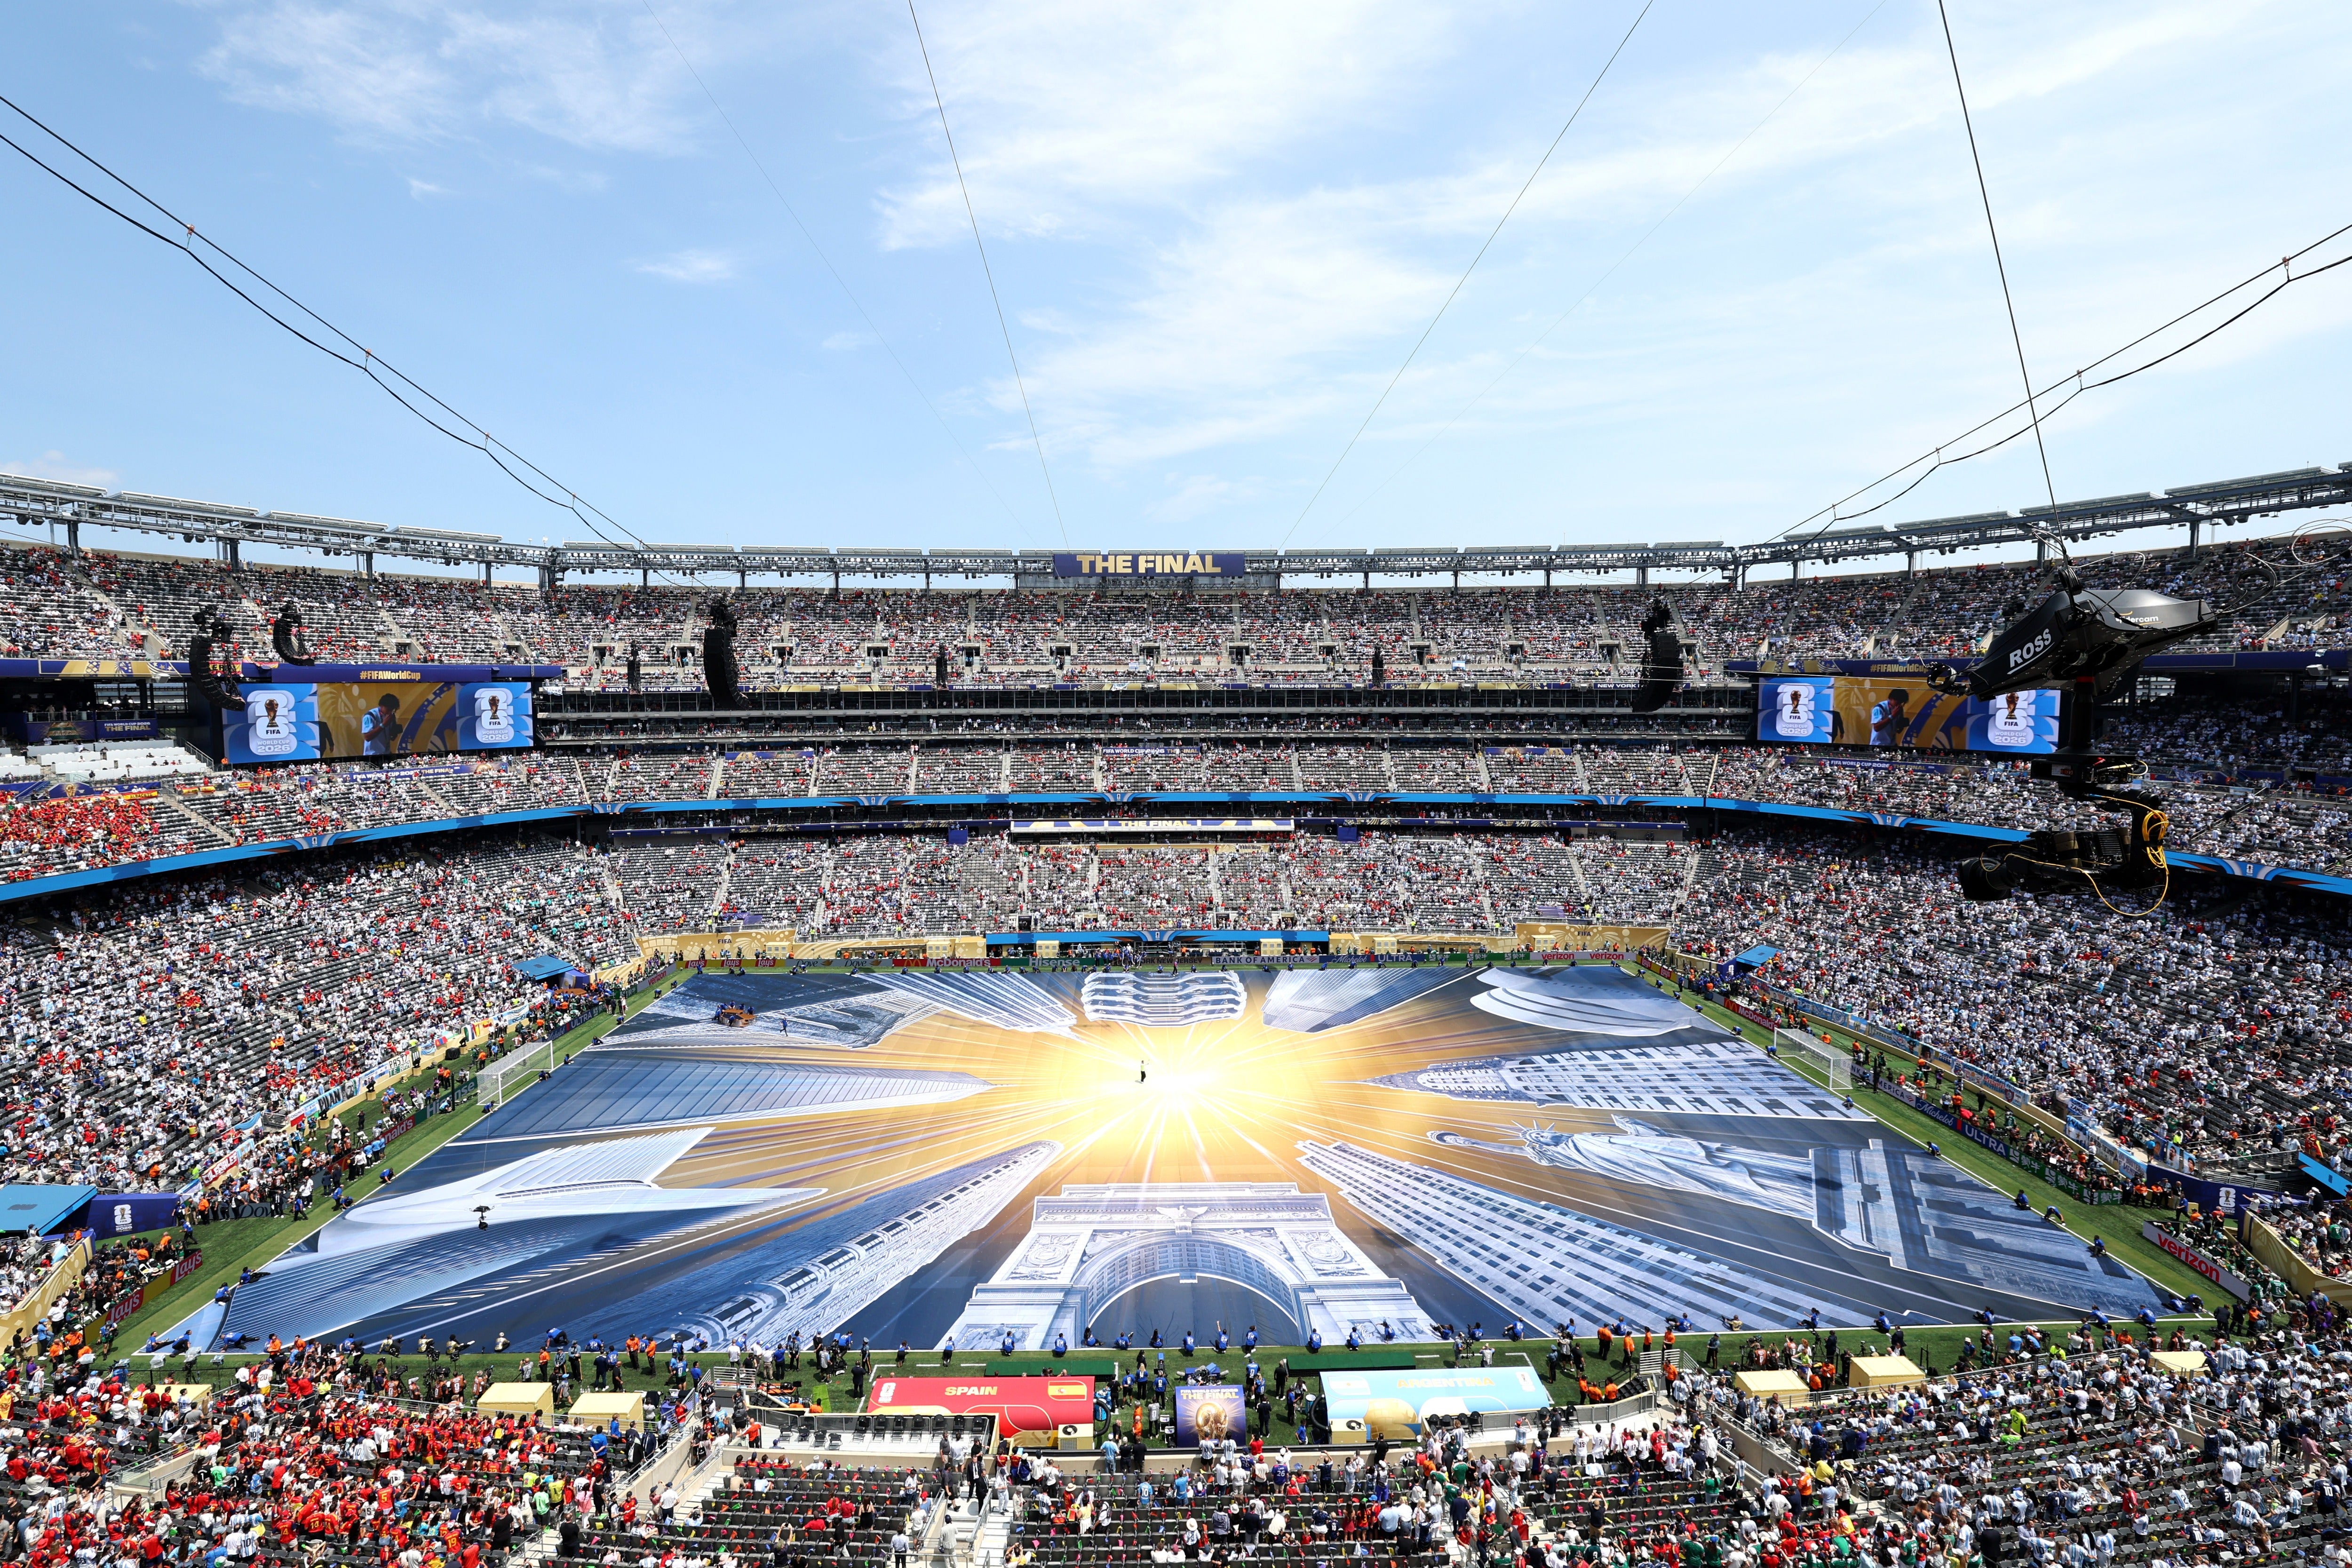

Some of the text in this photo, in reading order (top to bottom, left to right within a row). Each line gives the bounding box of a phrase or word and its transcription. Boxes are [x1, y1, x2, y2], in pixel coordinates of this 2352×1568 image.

[1077, 556, 1221, 573] THE FINAL
[2010, 629, 2052, 668] ROSS
[359, 670, 421, 680] #FIFAWorldCup
[796, 958, 818, 967] Dove
[926, 958, 991, 967] McDonald's
[1029, 958, 1080, 966] Hisense
[648, 971, 667, 986] verizon
[572, 1012, 592, 1028] ULTRA
[1739, 1006, 1778, 1029] McDonald's
[1878, 1081, 1905, 1098] MERICA
[385, 1119, 413, 1143] nald's
[1916, 1100, 2006, 1156] Michelob ULTRA
[2021, 1155, 2041, 1173] 蒙牛
[2058, 1175, 2078, 1194] 蒙牛
[2101, 1193, 2122, 1204] 蒙牛
[239, 1204, 272, 1218] Dov
[2158, 1233, 2220, 1283] verizon
[175, 1250, 202, 1283] Lay's
[111, 1293, 140, 1323] Lay's
[1398, 1377, 1495, 1388] ARGENTINA
[945, 1386, 997, 1396] SPAIN
[2012, 1416, 2018, 1424] 12
[2324, 1487, 2333, 1496] 10
[382, 1493, 387, 1502] 5
[2182, 1495, 2187, 1504] 2
[54, 1503, 62, 1512] 10
[2242, 1507, 2251, 1517] 10
[2195, 1532, 2202, 1541] 10
[243, 1538, 251, 1547] 10
[448, 1538, 457, 1548] 19
